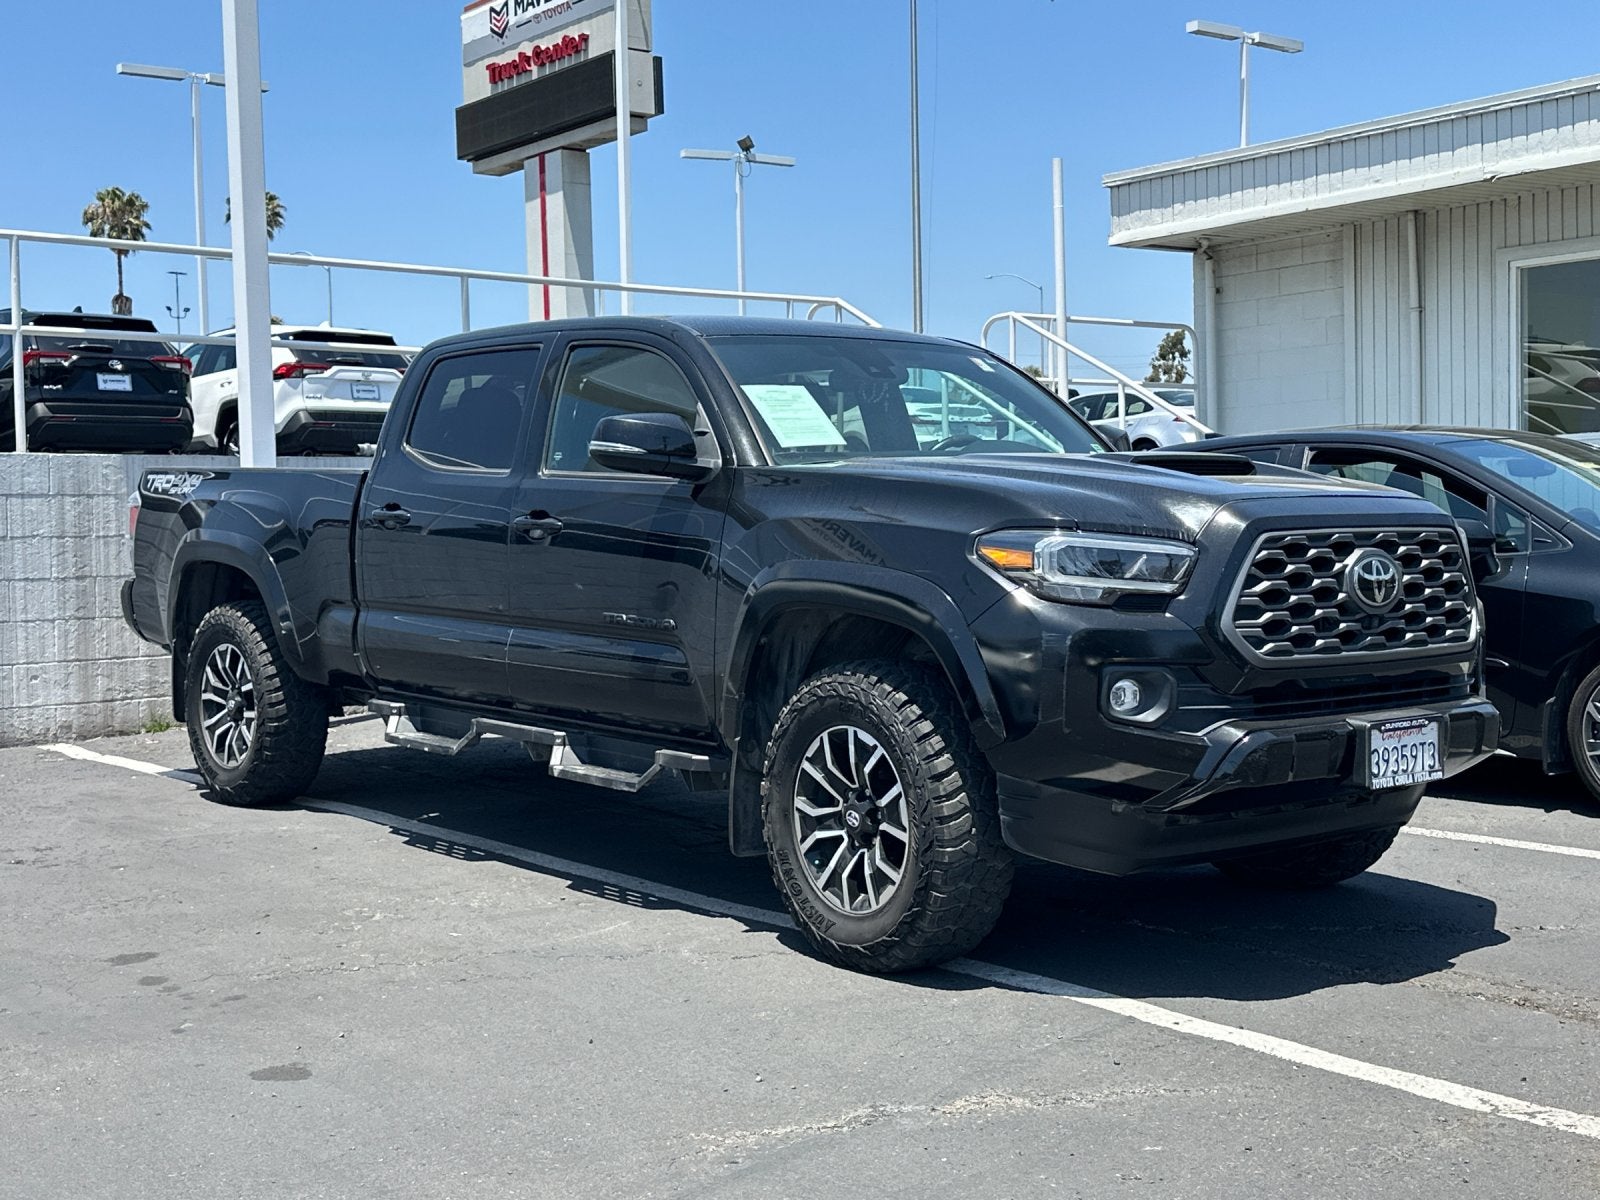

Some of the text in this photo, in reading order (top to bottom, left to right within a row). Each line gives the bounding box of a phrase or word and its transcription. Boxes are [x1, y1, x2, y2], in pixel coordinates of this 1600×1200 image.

[541, 1, 573, 20] TOYOTA
[486, 33, 589, 84] Truck Center
[1371, 741, 1435, 778] 39359T3
[1372, 776, 1394, 789] TOYOTA
[1395, 773, 1413, 785] CHULA
